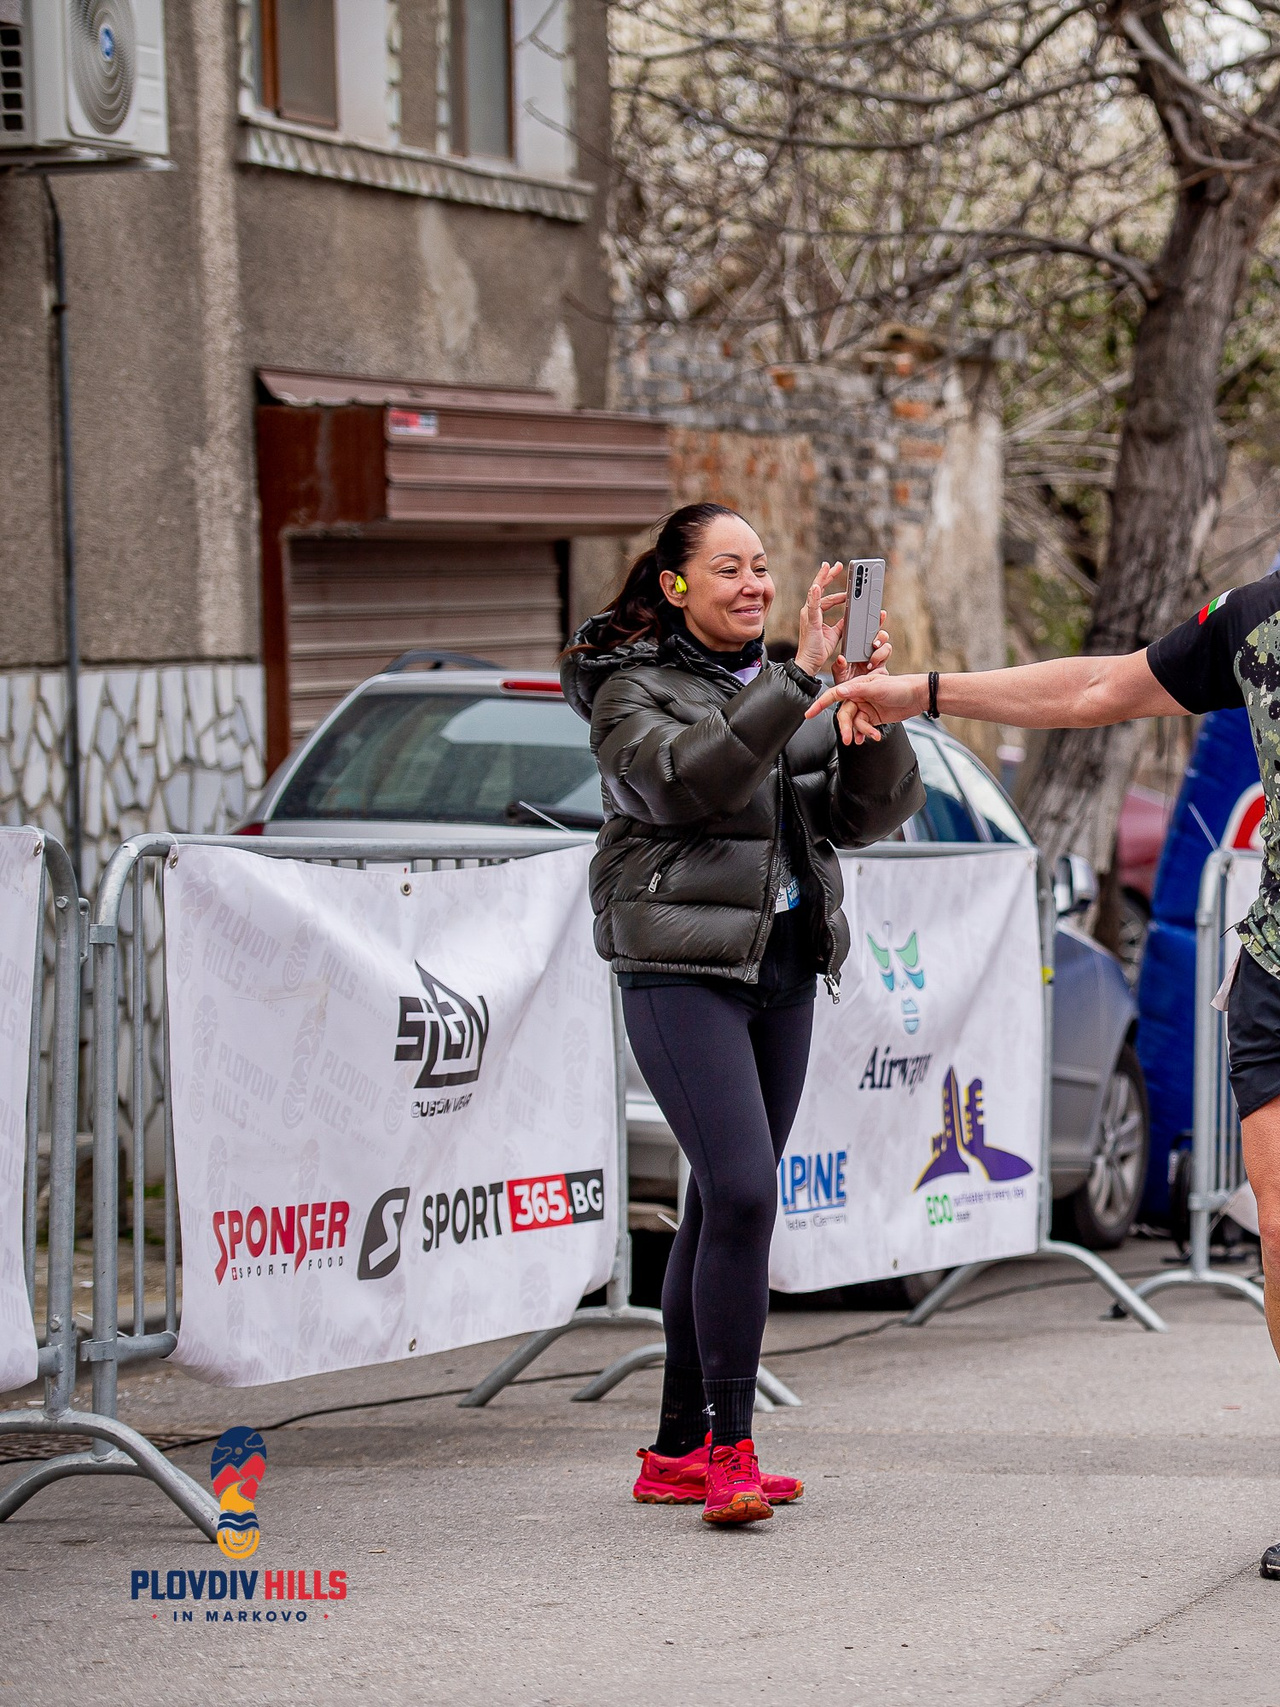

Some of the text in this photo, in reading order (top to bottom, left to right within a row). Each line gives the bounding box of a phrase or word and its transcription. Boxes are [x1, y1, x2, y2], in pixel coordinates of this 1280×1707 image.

[780, 1150, 847, 1207] LPINE
[926, 1194, 954, 1226] ECO
[212, 1200, 350, 1286] SPONSER
[238, 1262, 288, 1279] SPORT
[307, 1255, 344, 1271] FOOD
